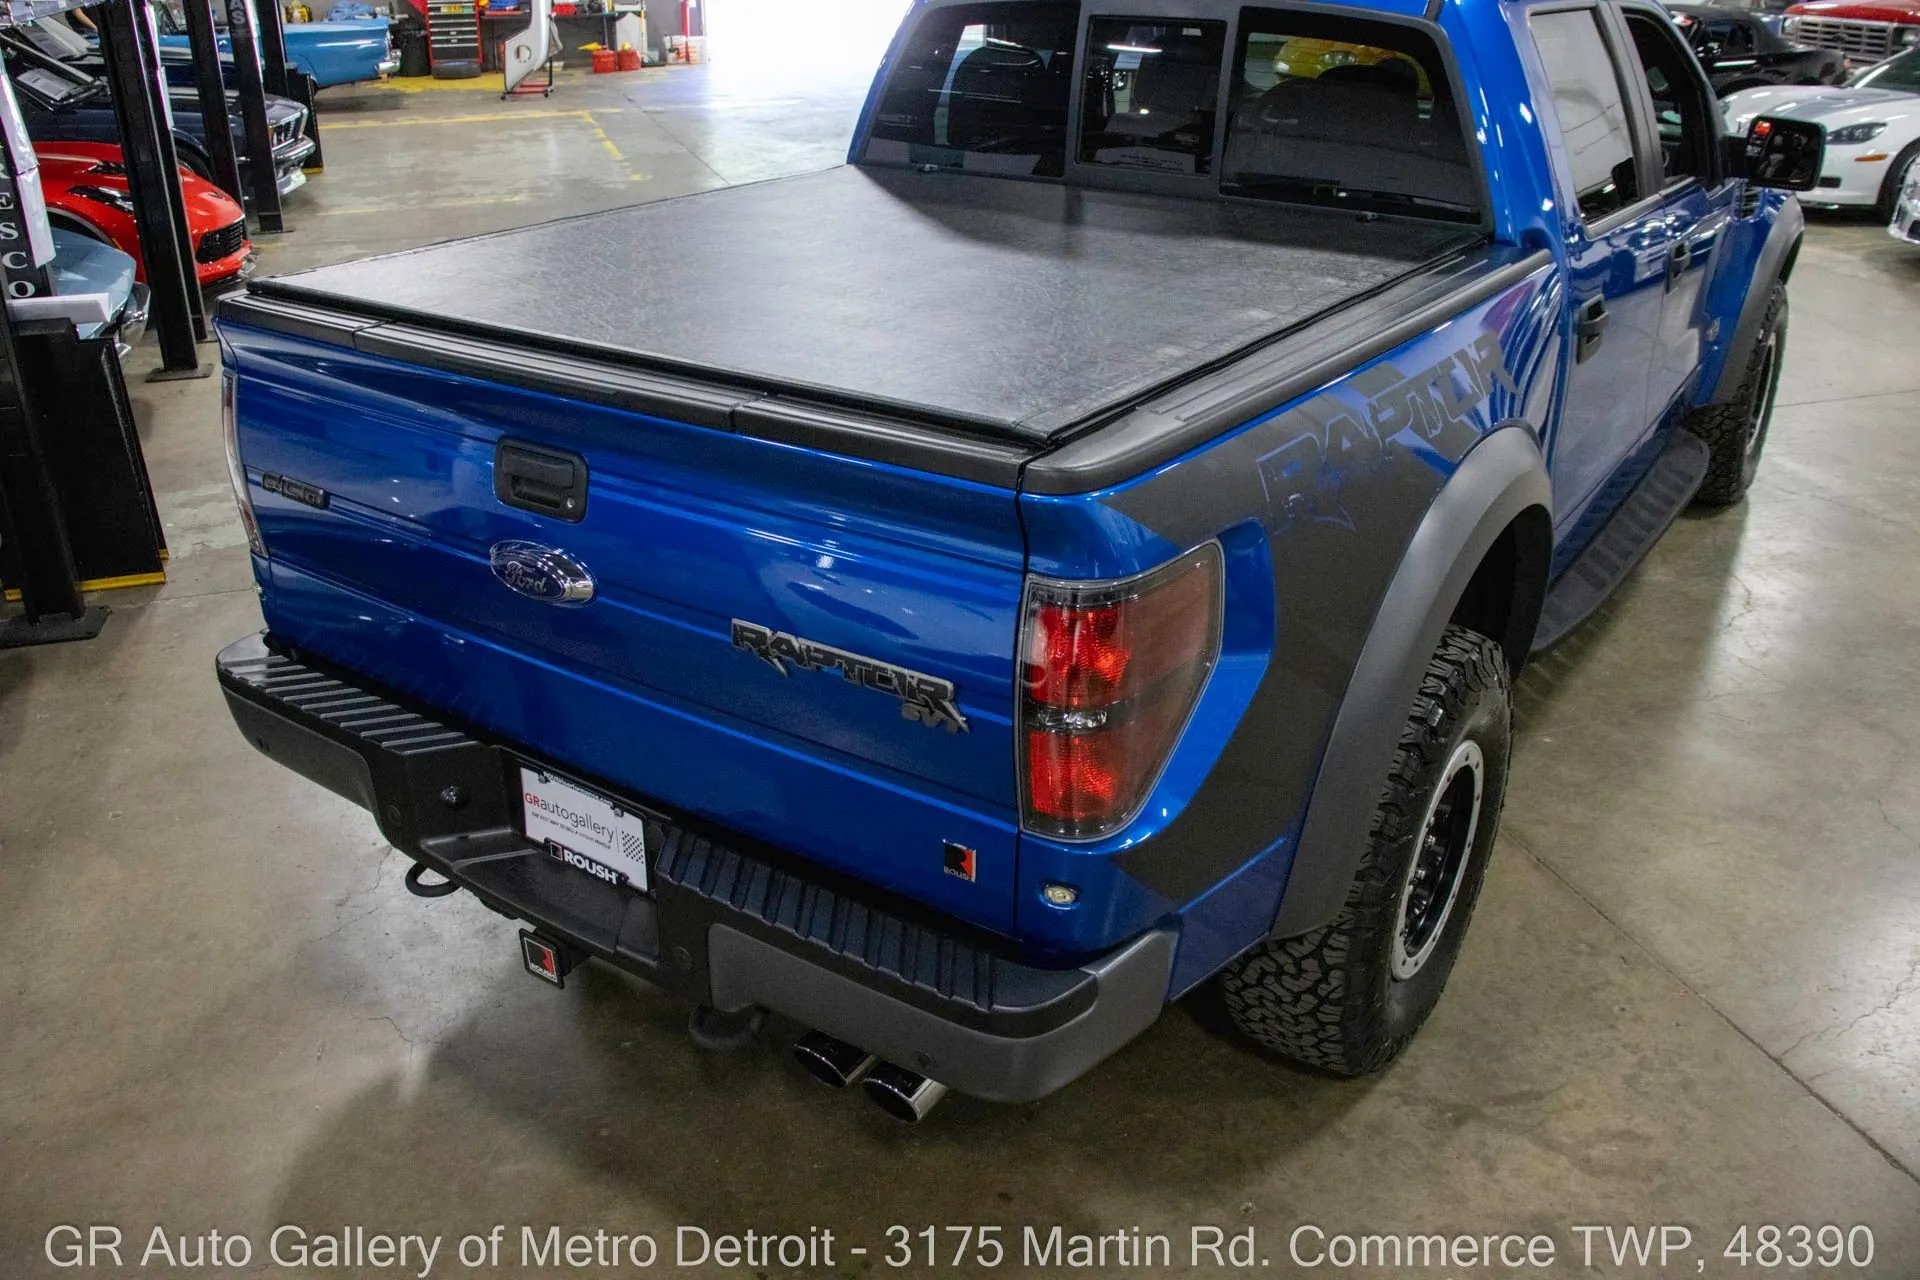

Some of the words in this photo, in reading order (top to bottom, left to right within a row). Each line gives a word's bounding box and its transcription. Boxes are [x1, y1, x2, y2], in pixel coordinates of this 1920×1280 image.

[504, 561, 548, 593] Ford
[731, 617, 970, 734] RAPTOR
[525, 792, 614, 843] GRautogallery
[564, 850, 617, 884] ROUSH
